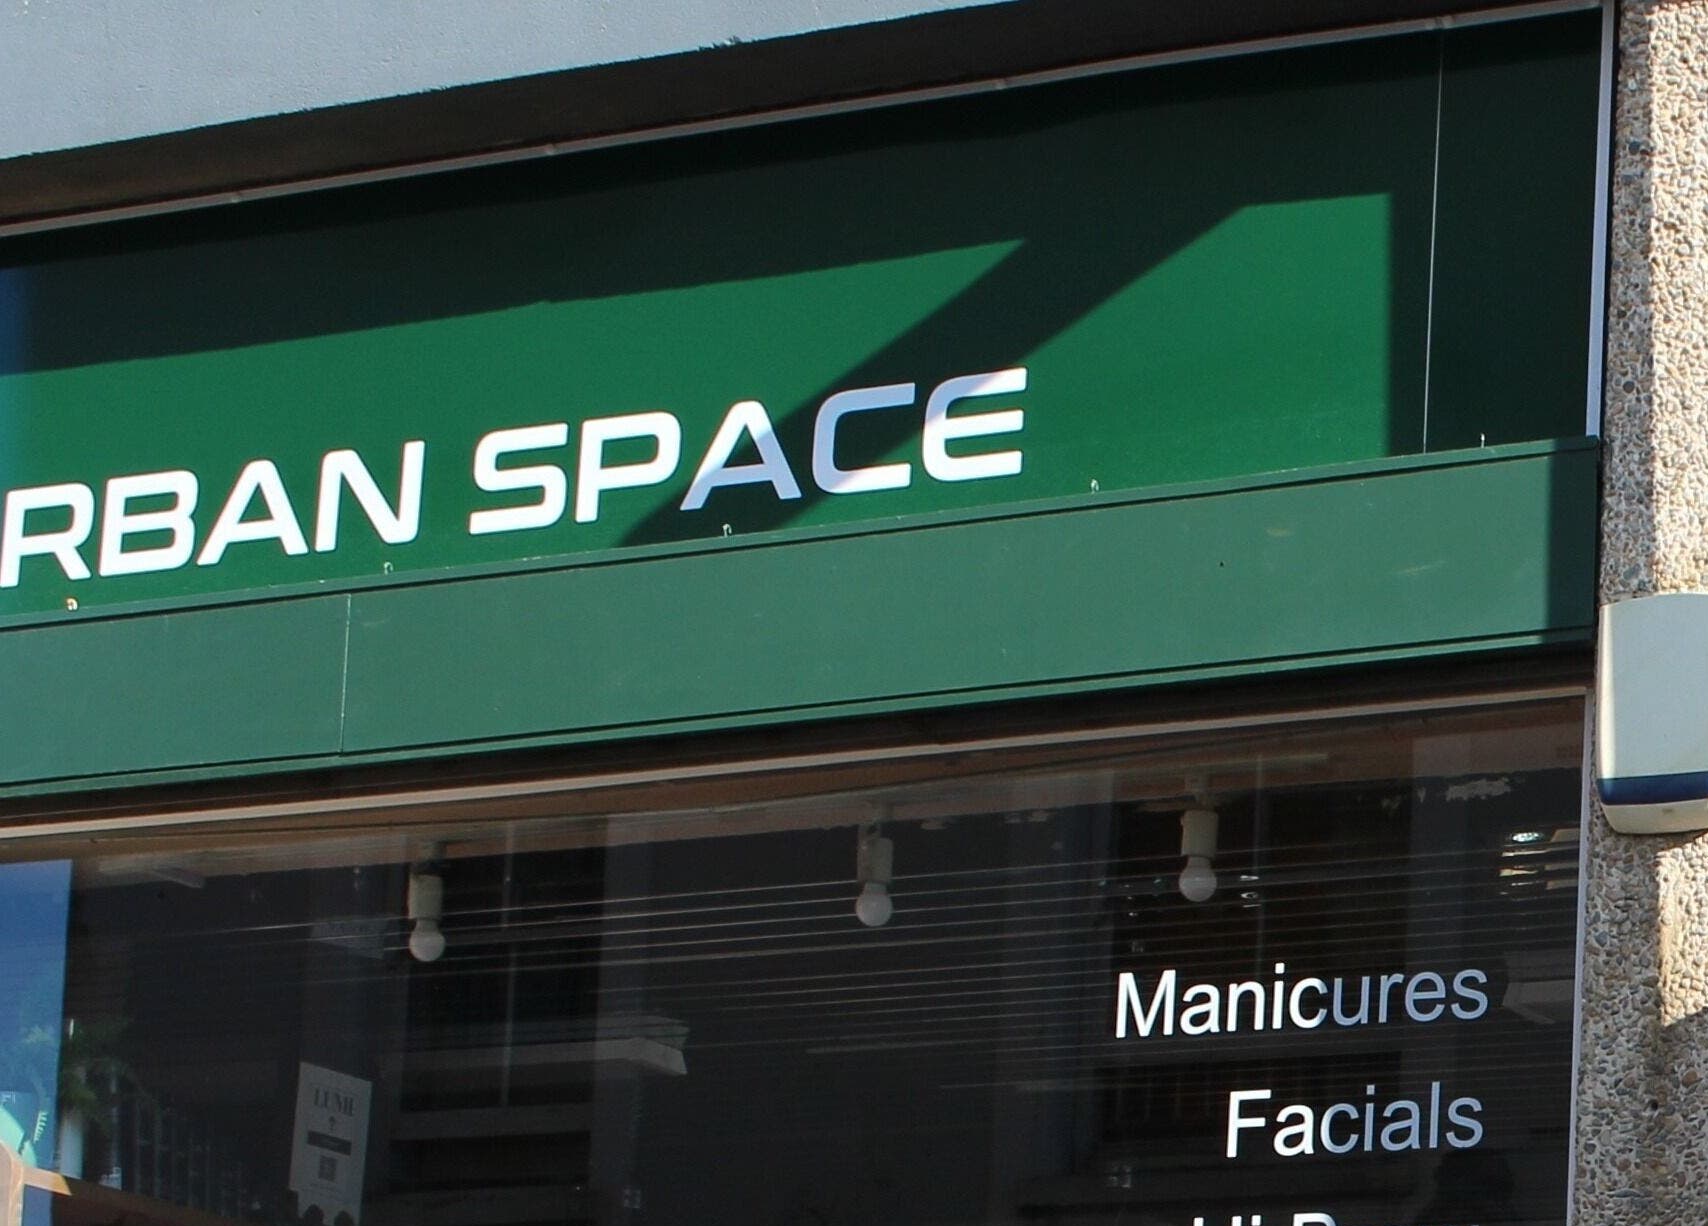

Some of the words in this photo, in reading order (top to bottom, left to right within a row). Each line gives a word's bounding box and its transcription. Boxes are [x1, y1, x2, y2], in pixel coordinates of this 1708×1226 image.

[0, 440, 425, 588] RBAN
[469, 367, 1028, 535] SPACE
[1115, 962, 1488, 1039] Manicures
[1226, 1081, 1483, 1159] Facials
